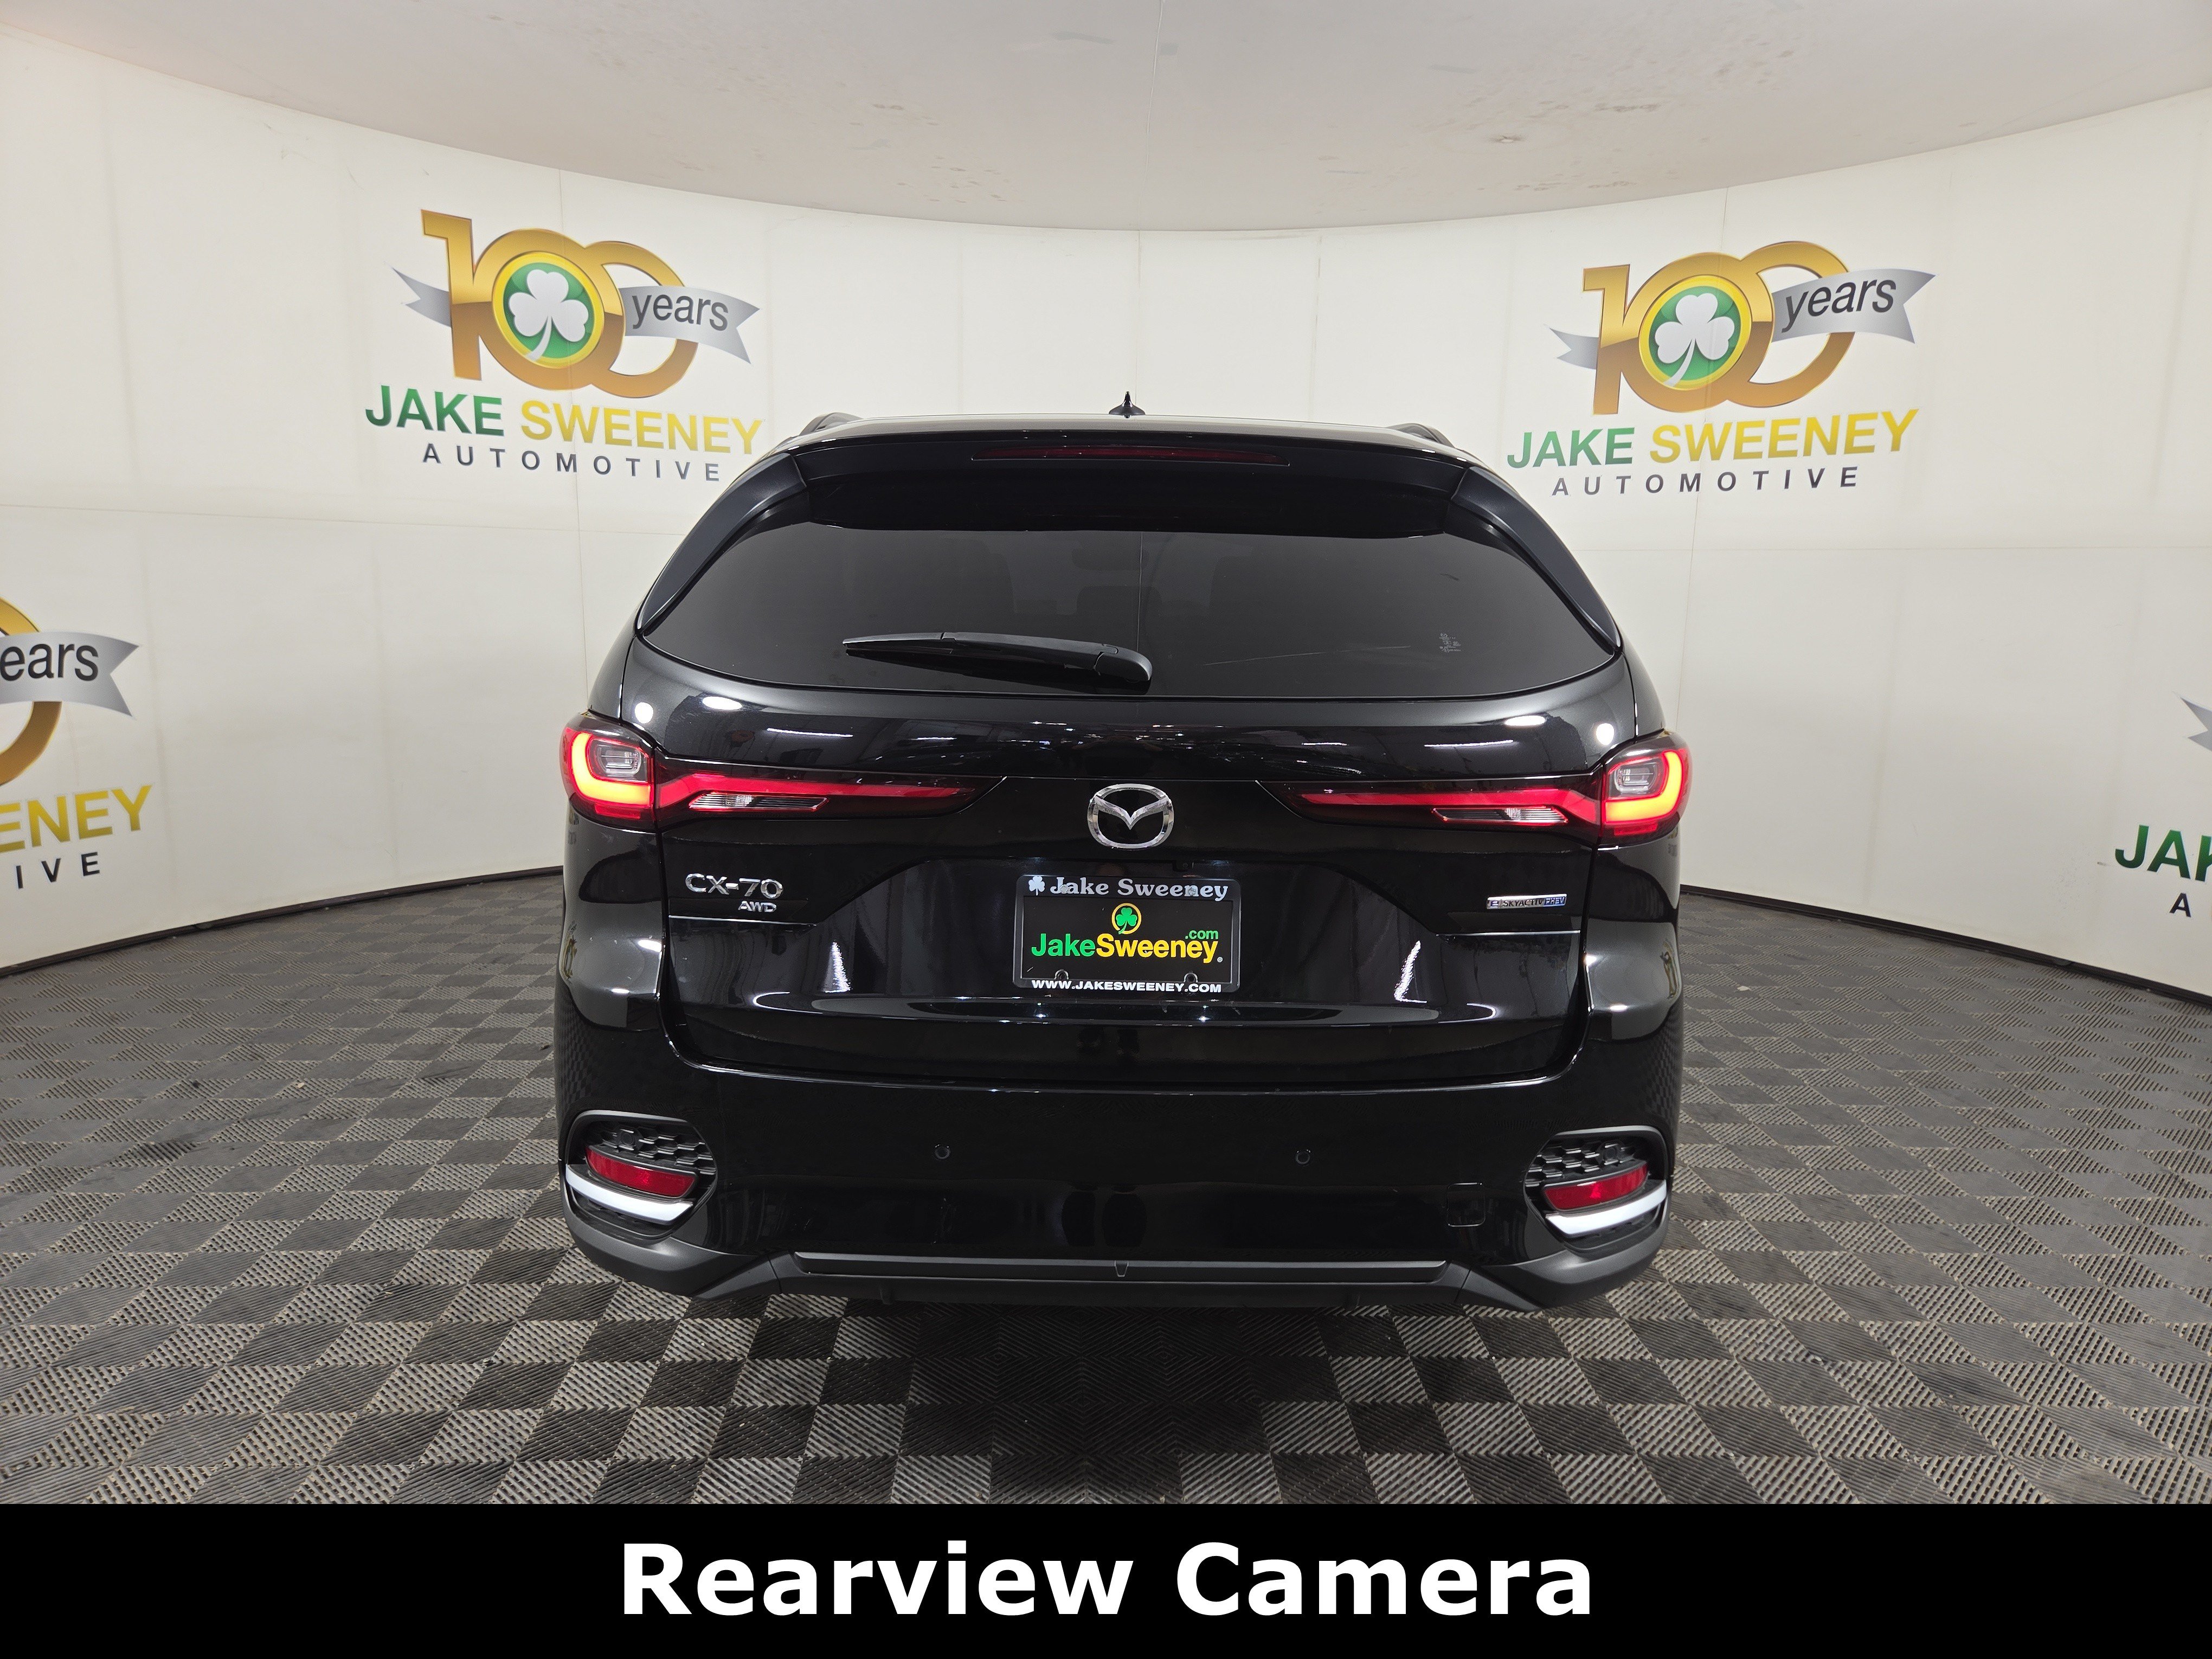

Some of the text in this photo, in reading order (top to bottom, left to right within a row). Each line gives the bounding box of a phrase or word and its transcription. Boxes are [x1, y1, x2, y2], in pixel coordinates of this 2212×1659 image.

[421, 209, 728, 398] 100 years
[1583, 241, 1896, 415] 100 years
[365, 385, 763, 454] JAKE SWEENEY
[1507, 409, 1919, 468] JAKE SWEENEY
[422, 443, 720, 482] AUTOMOTIVE
[1552, 466, 1859, 496] AUTOMOTIVE
[685, 873, 784, 899] CX-70
[1050, 877, 1229, 902] Jake Sweeney
[738, 901, 777, 912] AWD
[1502, 898, 1544, 907] SKYACTIV
[1545, 897, 1565, 905] PHEV
[1185, 930, 1219, 940] .com
[1031, 980, 1222, 993] WWW.JAKESWEENEY.COM
